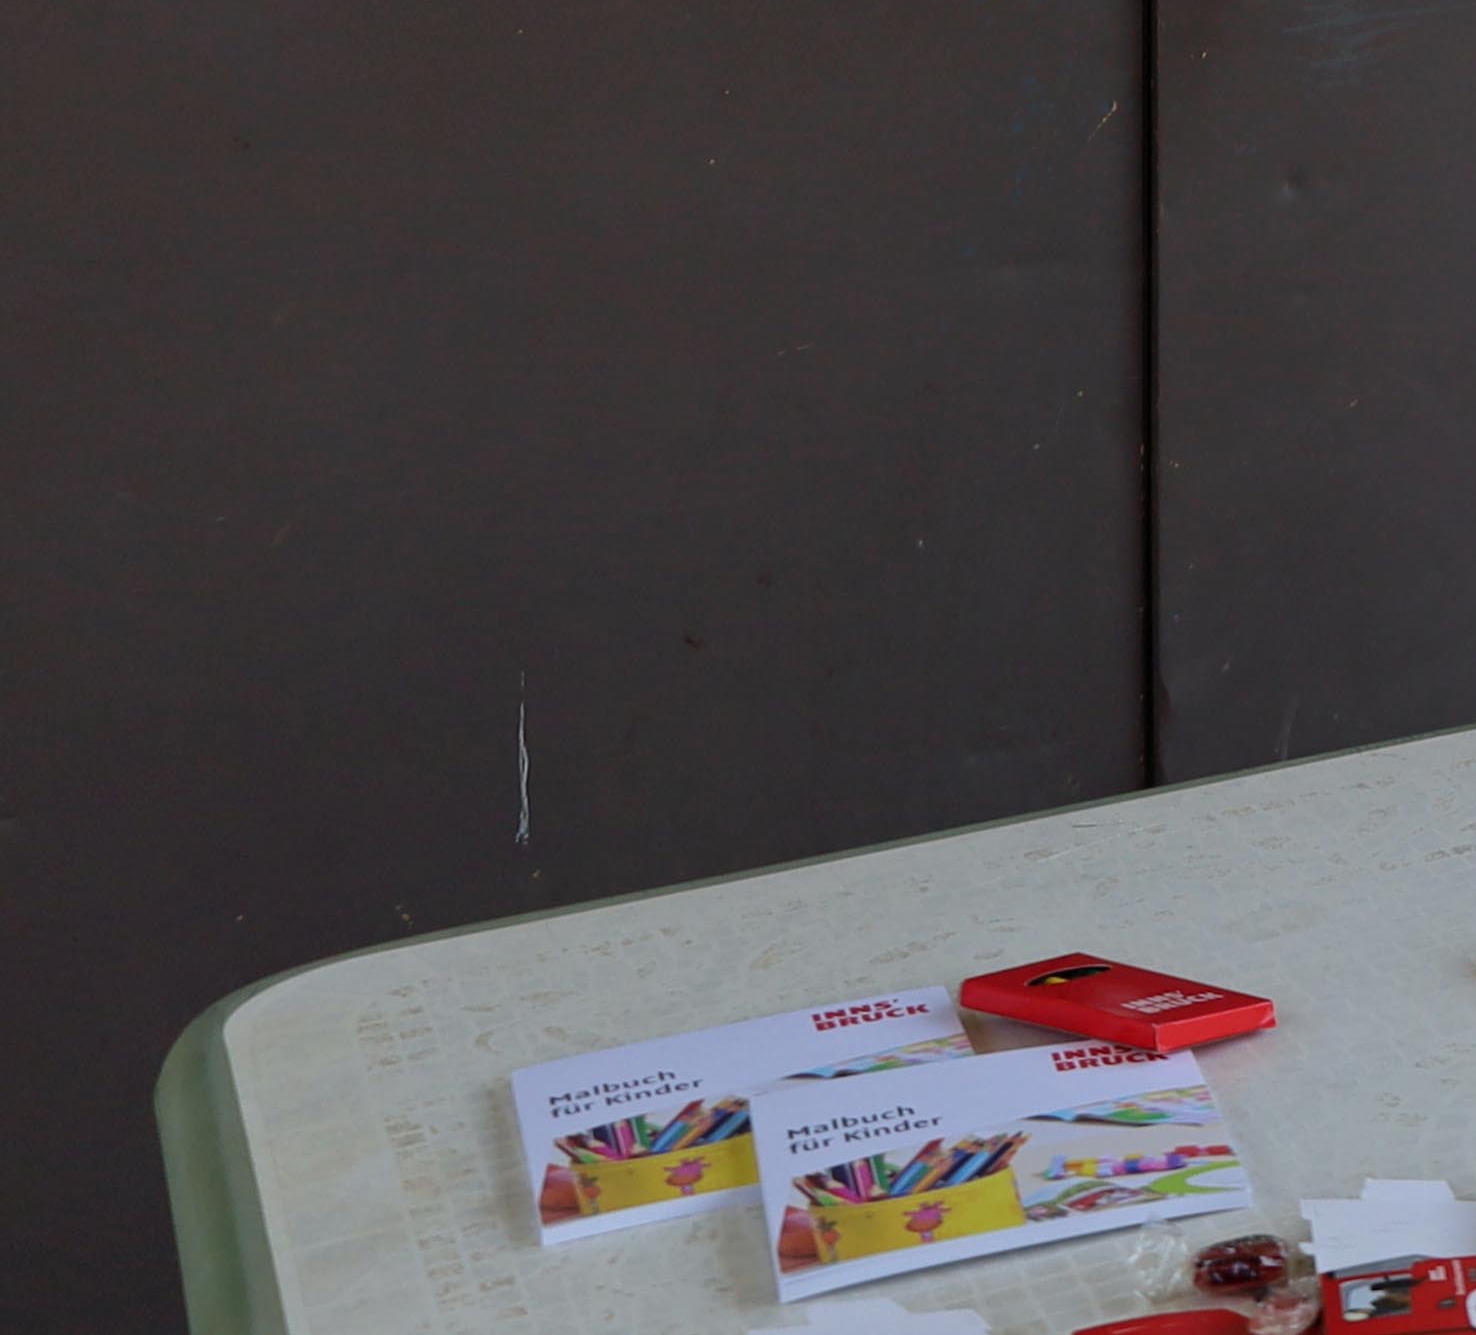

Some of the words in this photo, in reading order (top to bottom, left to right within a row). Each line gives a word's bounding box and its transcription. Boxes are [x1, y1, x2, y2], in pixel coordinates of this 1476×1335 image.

[811, 998, 900, 1022] INNS'
[815, 1003, 930, 1032] BRUCK
[1055, 1052, 1169, 1072] BRUCK
[548, 1068, 677, 1106] Malbuch
[551, 1099, 594, 1119] für
[604, 1078, 704, 1108] Kinder
[787, 1105, 915, 1139] Malbuch
[789, 1134, 833, 1155] für
[842, 1114, 944, 1143] Kinder
